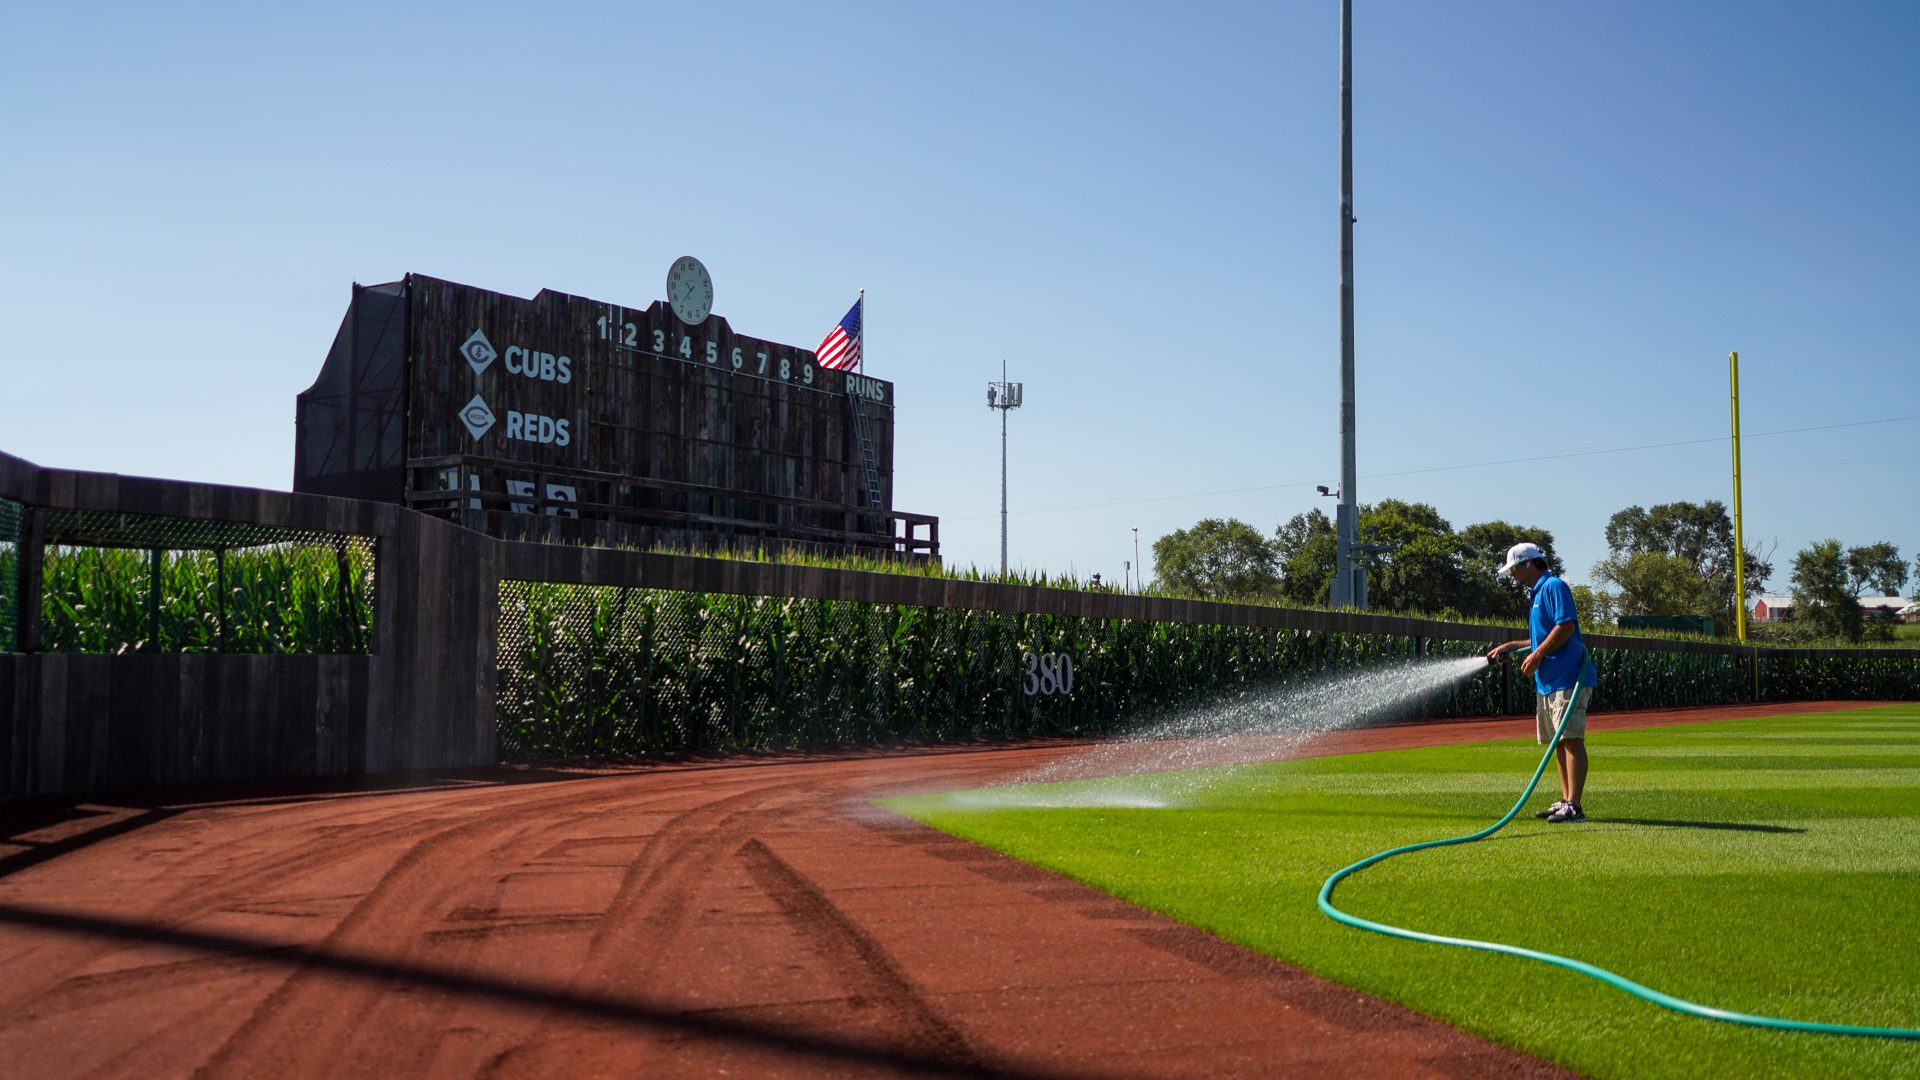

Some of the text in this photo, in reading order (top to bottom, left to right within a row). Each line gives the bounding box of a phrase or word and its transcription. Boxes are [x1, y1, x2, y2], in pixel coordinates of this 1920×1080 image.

[505, 345, 572, 384] CUBS
[597, 316, 884, 400] 1 2 3 4 5 6 7 8 9 RUNS
[507, 410, 571, 446] REDS
[1023, 652, 1073, 696] 380
